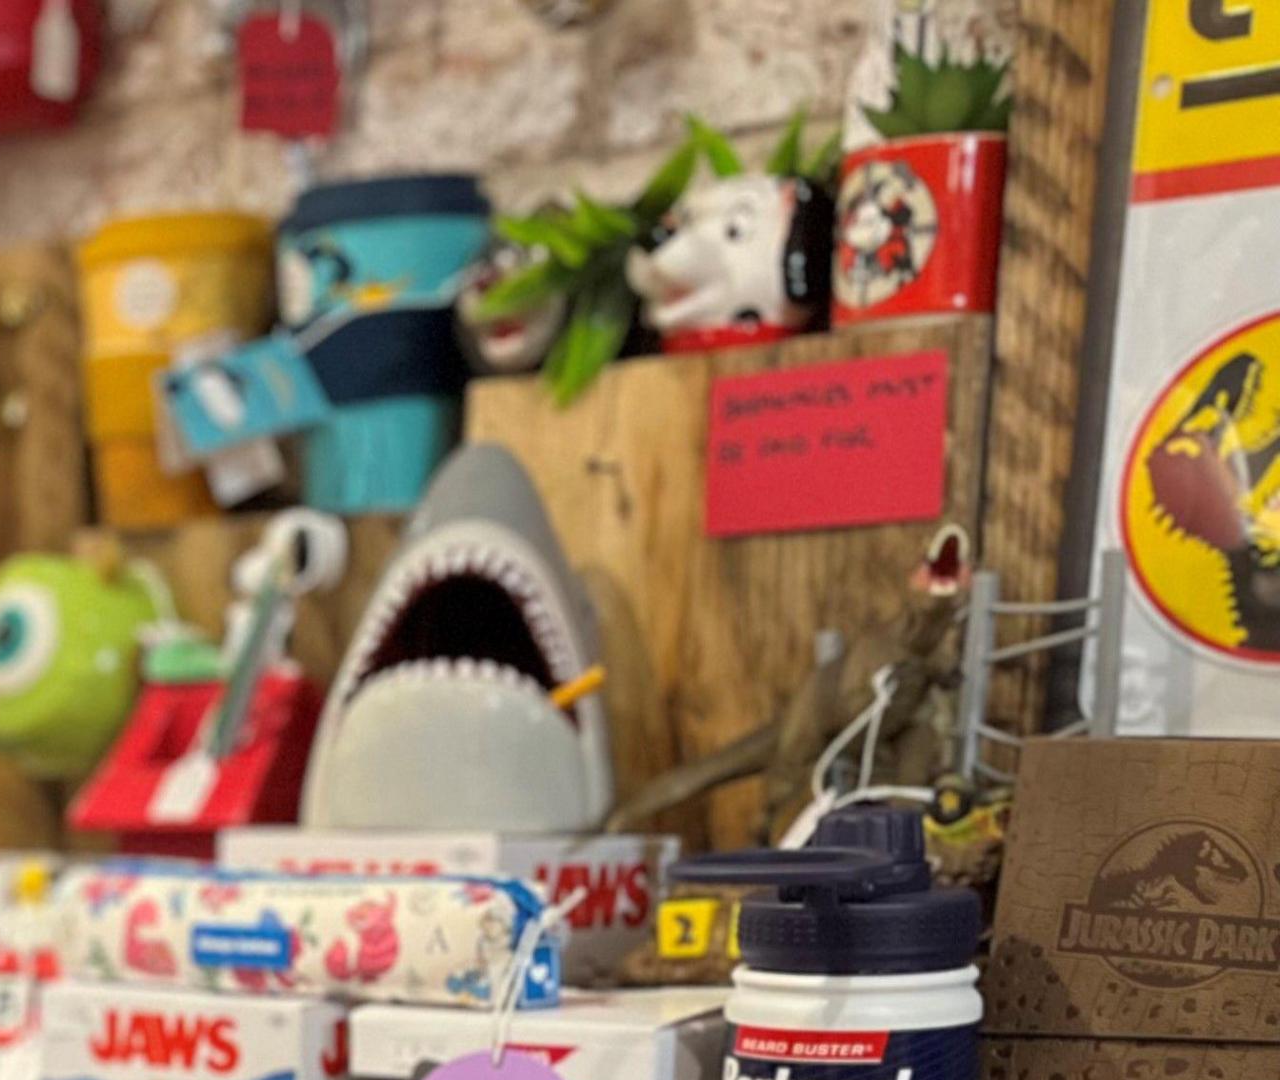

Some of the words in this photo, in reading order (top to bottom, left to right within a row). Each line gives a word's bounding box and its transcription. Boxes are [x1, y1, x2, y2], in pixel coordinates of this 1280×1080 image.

[535, 863, 650, 929] AWS
[1060, 909, 1191, 954] JURASSIC
[1192, 918, 1279, 962] PARK
[90, 1007, 240, 1078] JAWS
